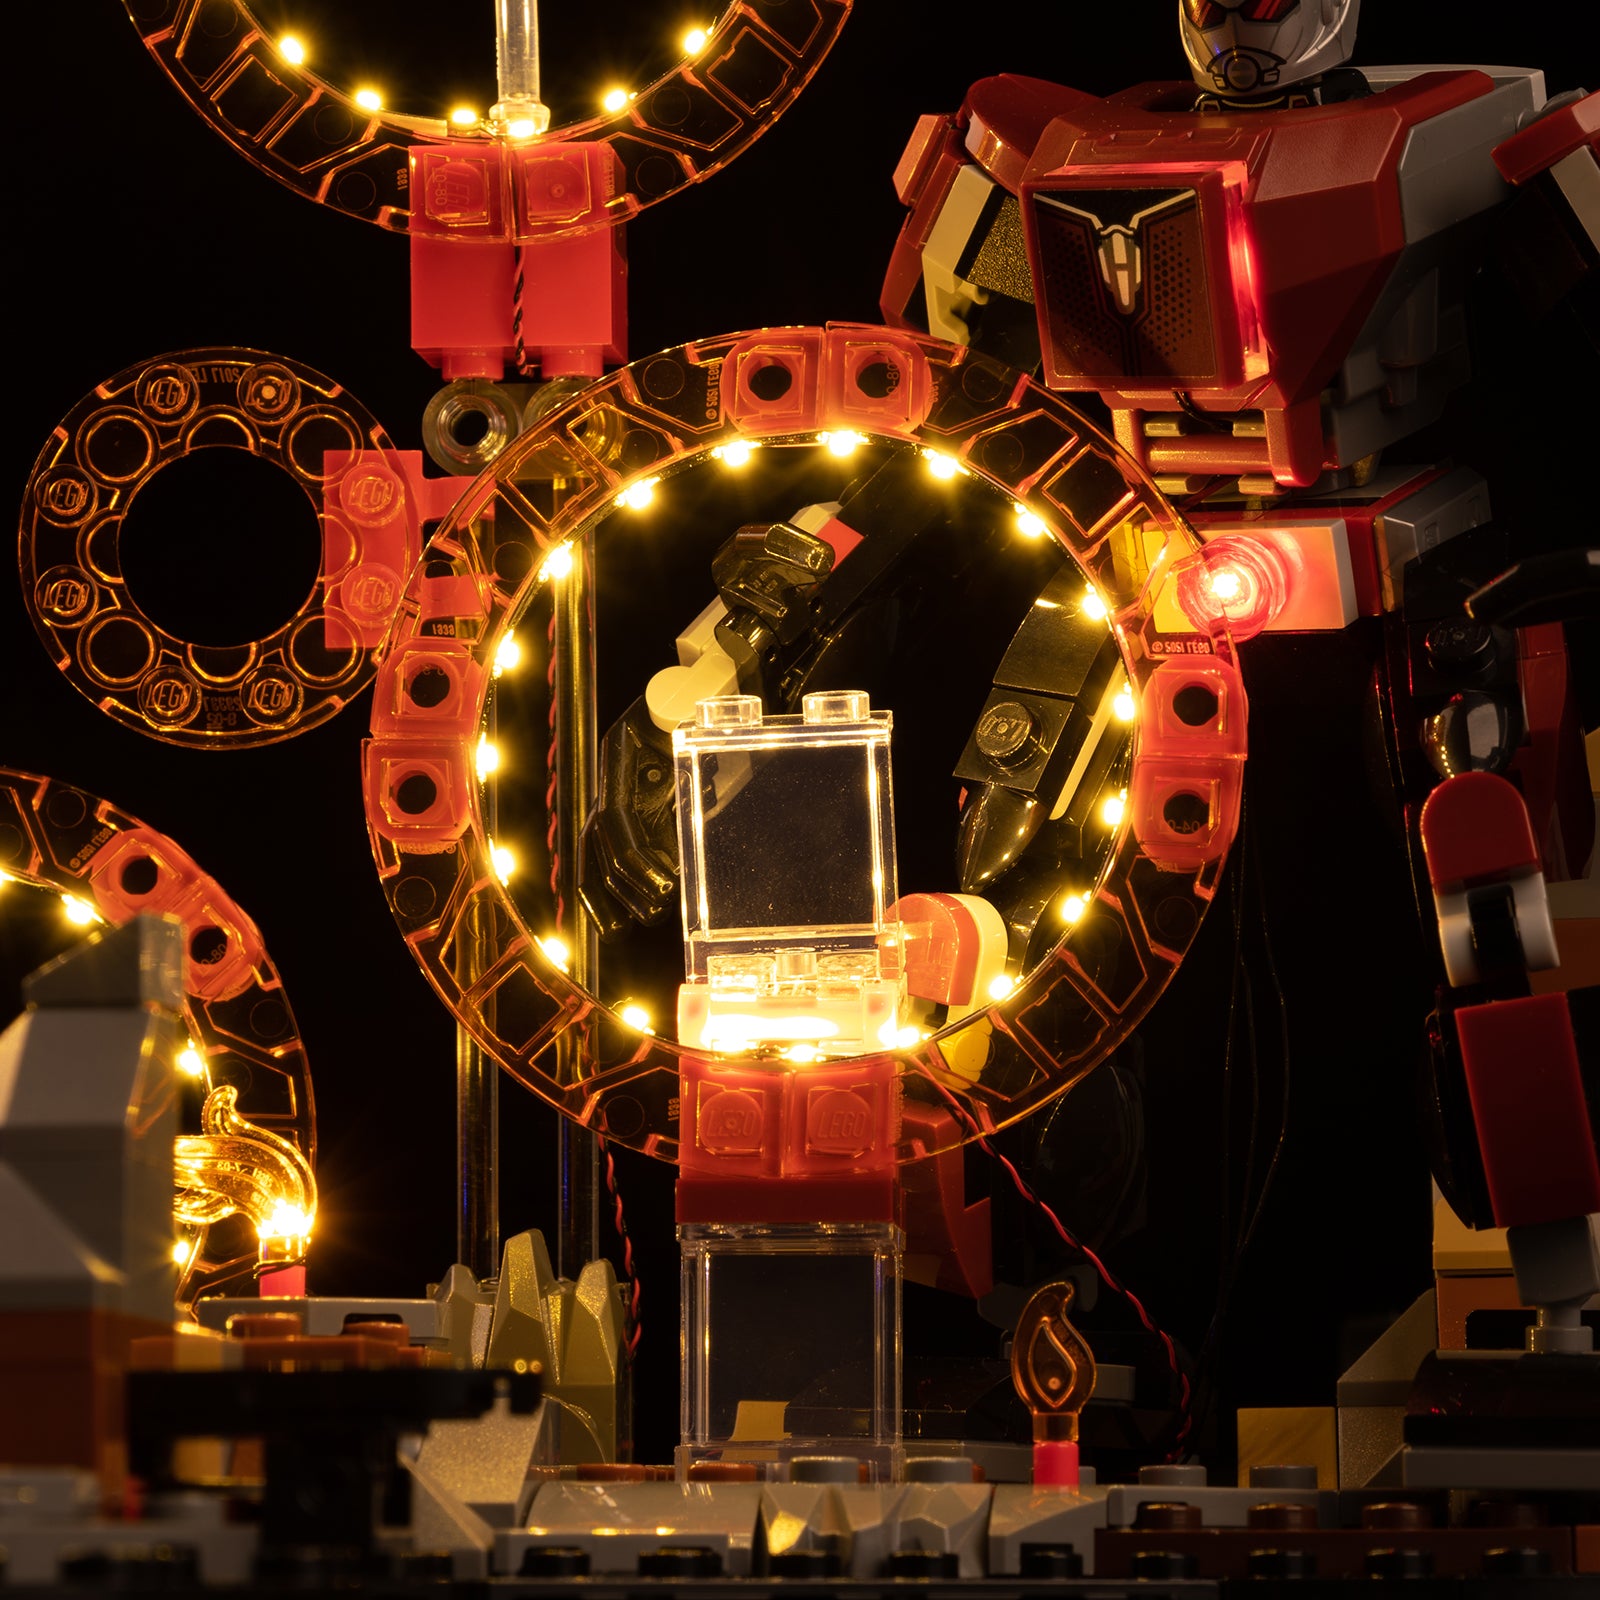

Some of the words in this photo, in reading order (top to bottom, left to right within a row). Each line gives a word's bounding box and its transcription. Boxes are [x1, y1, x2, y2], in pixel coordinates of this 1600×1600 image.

[144, 380, 190, 407] LEGO
[42, 482, 88, 508] LEGO
[347, 483, 394, 508] LEGO
[42, 582, 89, 609] LEGO
[349, 581, 395, 607] LEGO
[147, 684, 192, 710] LEGO
[247, 683, 294, 710] LEGO
[817, 1111, 866, 1138] LEGO
